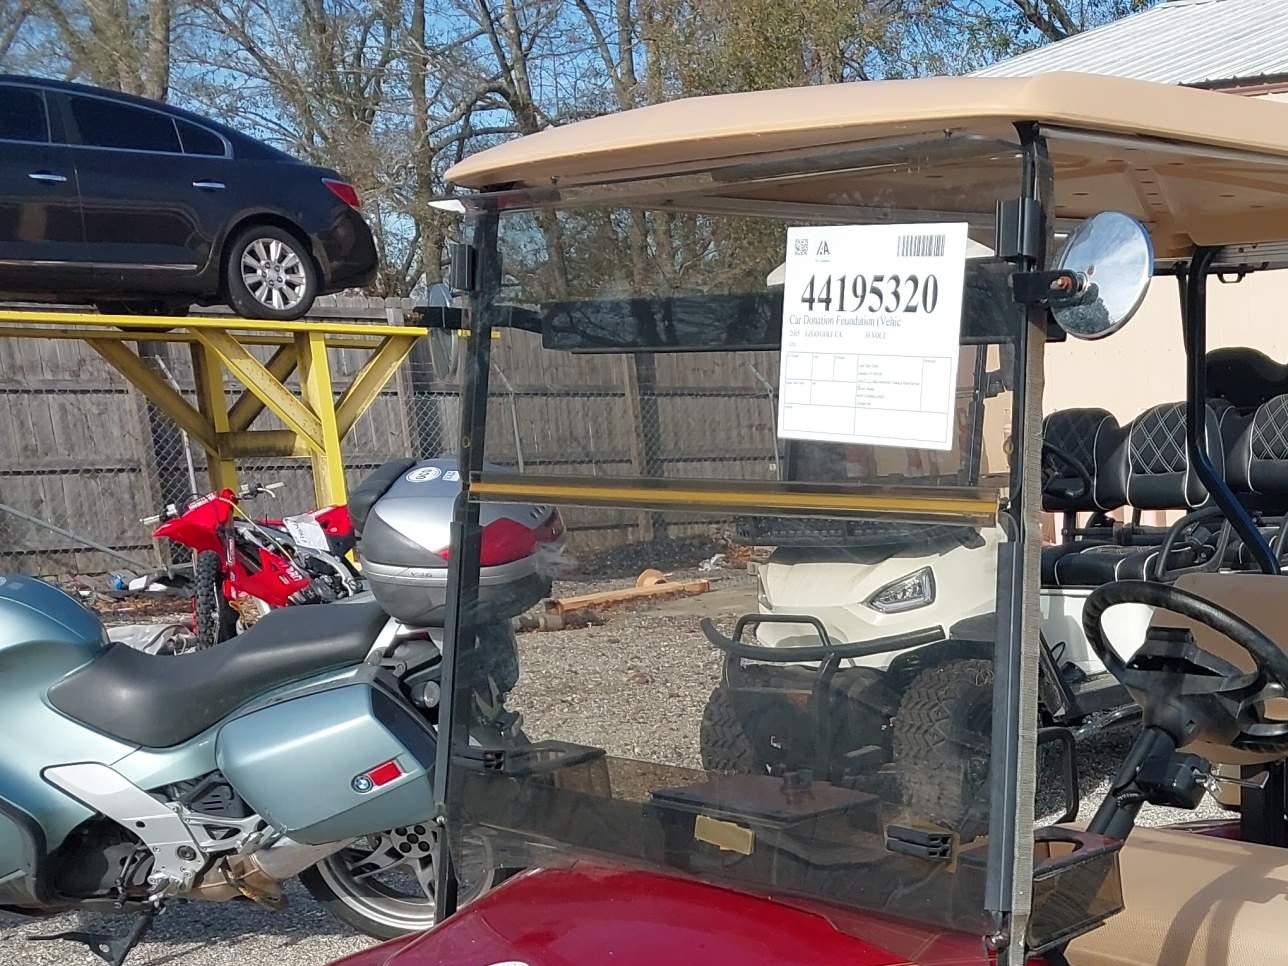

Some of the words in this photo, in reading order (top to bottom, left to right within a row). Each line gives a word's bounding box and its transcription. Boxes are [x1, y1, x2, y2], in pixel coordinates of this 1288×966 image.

[801, 273, 938, 314] 44195320
[789, 315, 802, 325] Car
[803, 315, 834, 326] Donation
[836, 315, 875, 327] Foundation
